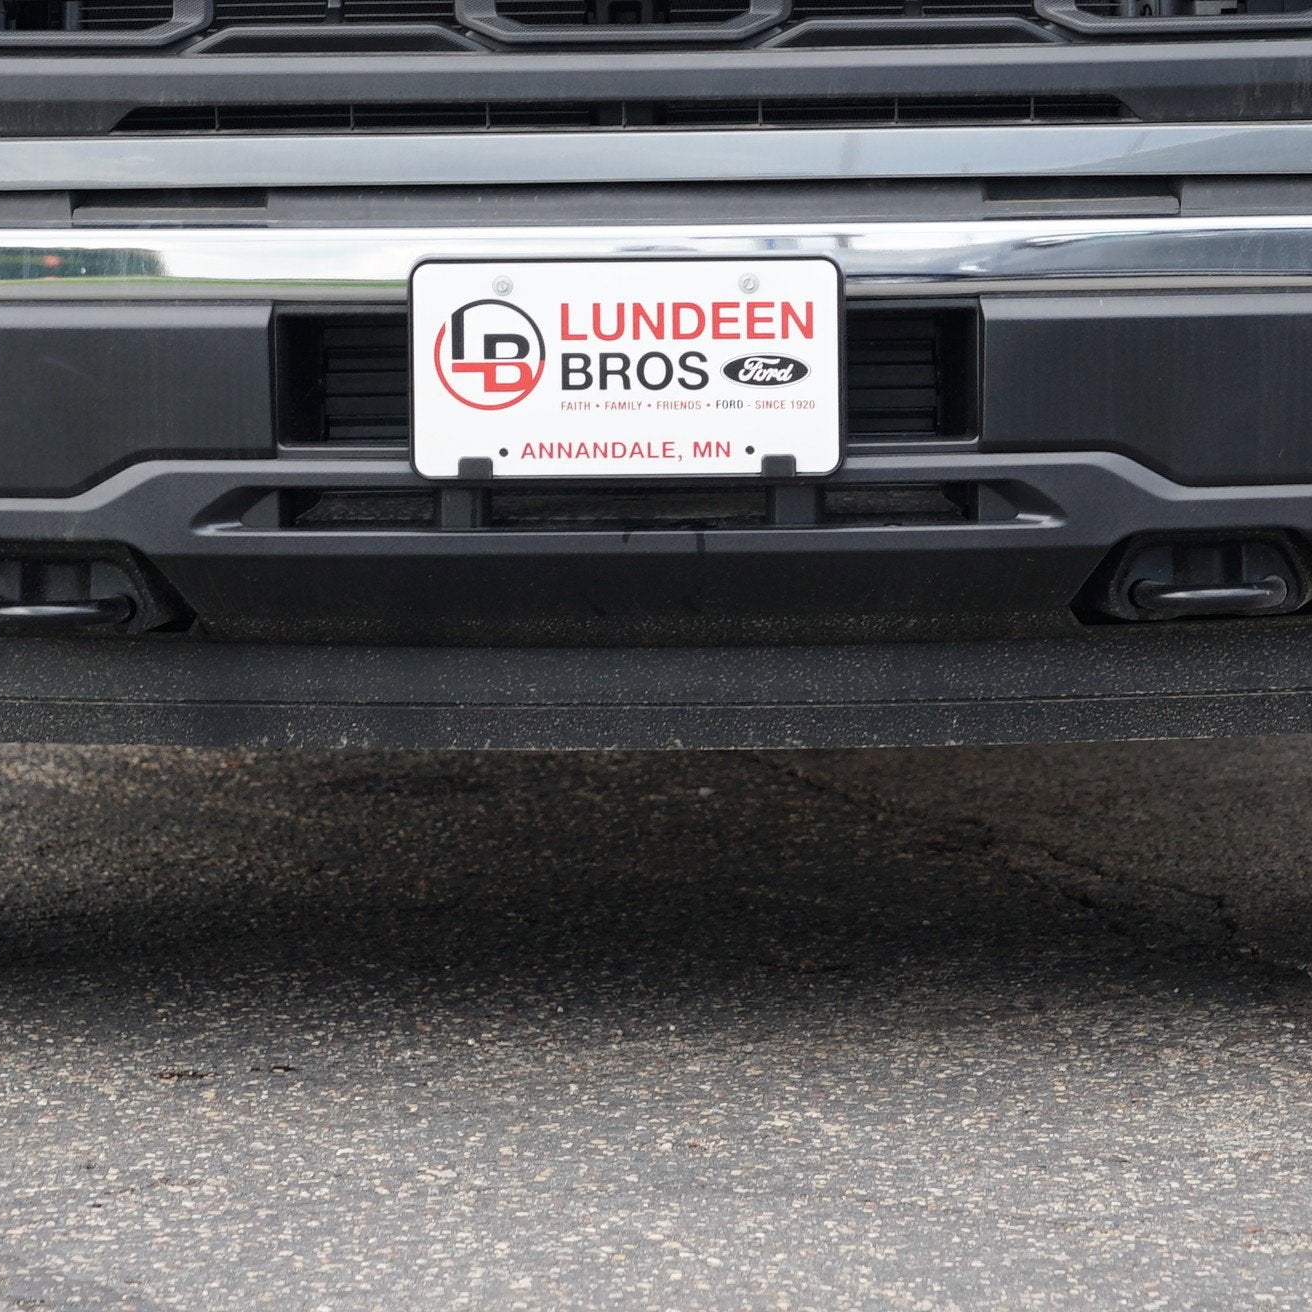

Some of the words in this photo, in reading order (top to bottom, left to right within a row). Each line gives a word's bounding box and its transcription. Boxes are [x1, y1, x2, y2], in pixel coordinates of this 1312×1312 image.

[560, 301, 814, 342] LUNDEEN
[561, 350, 710, 391] BROS
[738, 357, 794, 382] Ford
[561, 401, 591, 411] FAITH
[604, 401, 642, 411] FAMILY
[656, 400, 702, 410] FRIENDS
[715, 399, 744, 410] FORD
[755, 400, 786, 410] SINCE
[790, 399, 816, 410] 1920
[520, 441, 684, 462] ANNANDALE,
[692, 440, 731, 458] MN
